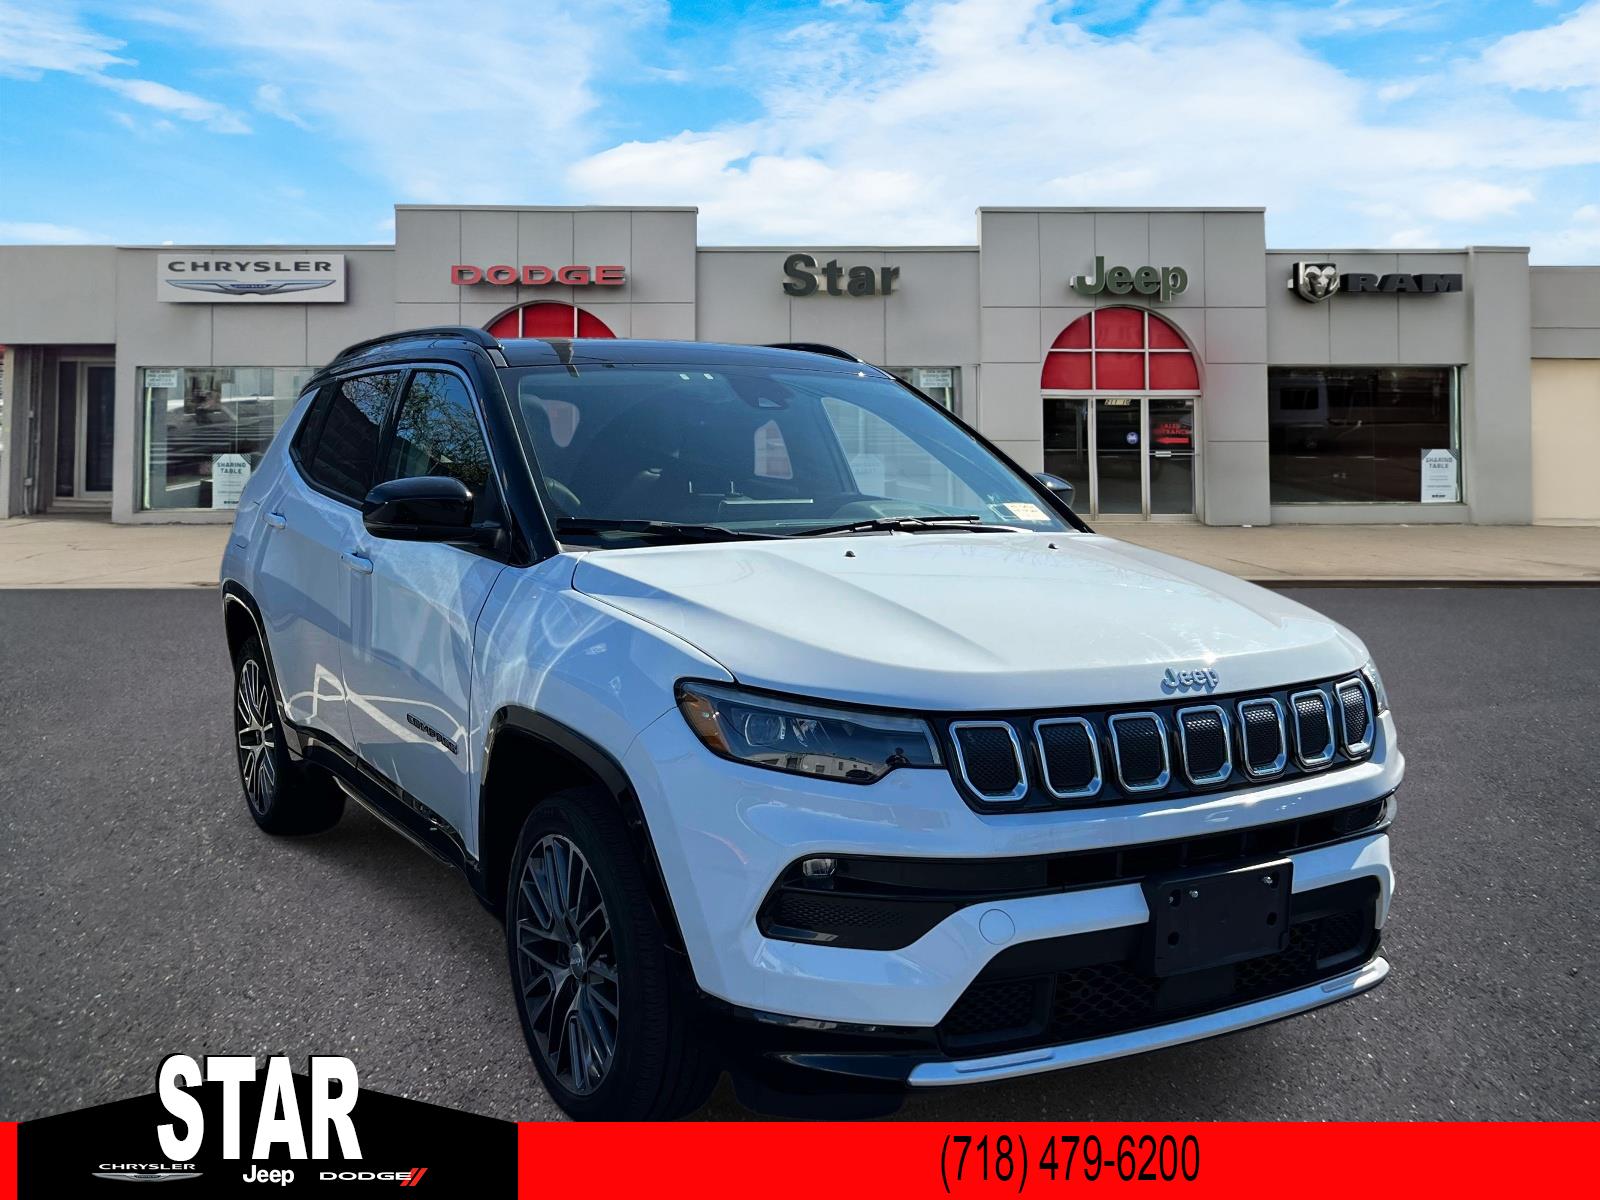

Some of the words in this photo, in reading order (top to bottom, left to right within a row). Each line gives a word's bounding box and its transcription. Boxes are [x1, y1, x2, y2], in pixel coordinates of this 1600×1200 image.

[167, 261, 333, 273] CHRYSLER
[451, 265, 627, 286] DODGE
[782, 253, 900, 297] Star
[1070, 255, 1189, 302] Jeep
[1340, 273, 1463, 292] RAM
[1161, 667, 1218, 692] Jeep
